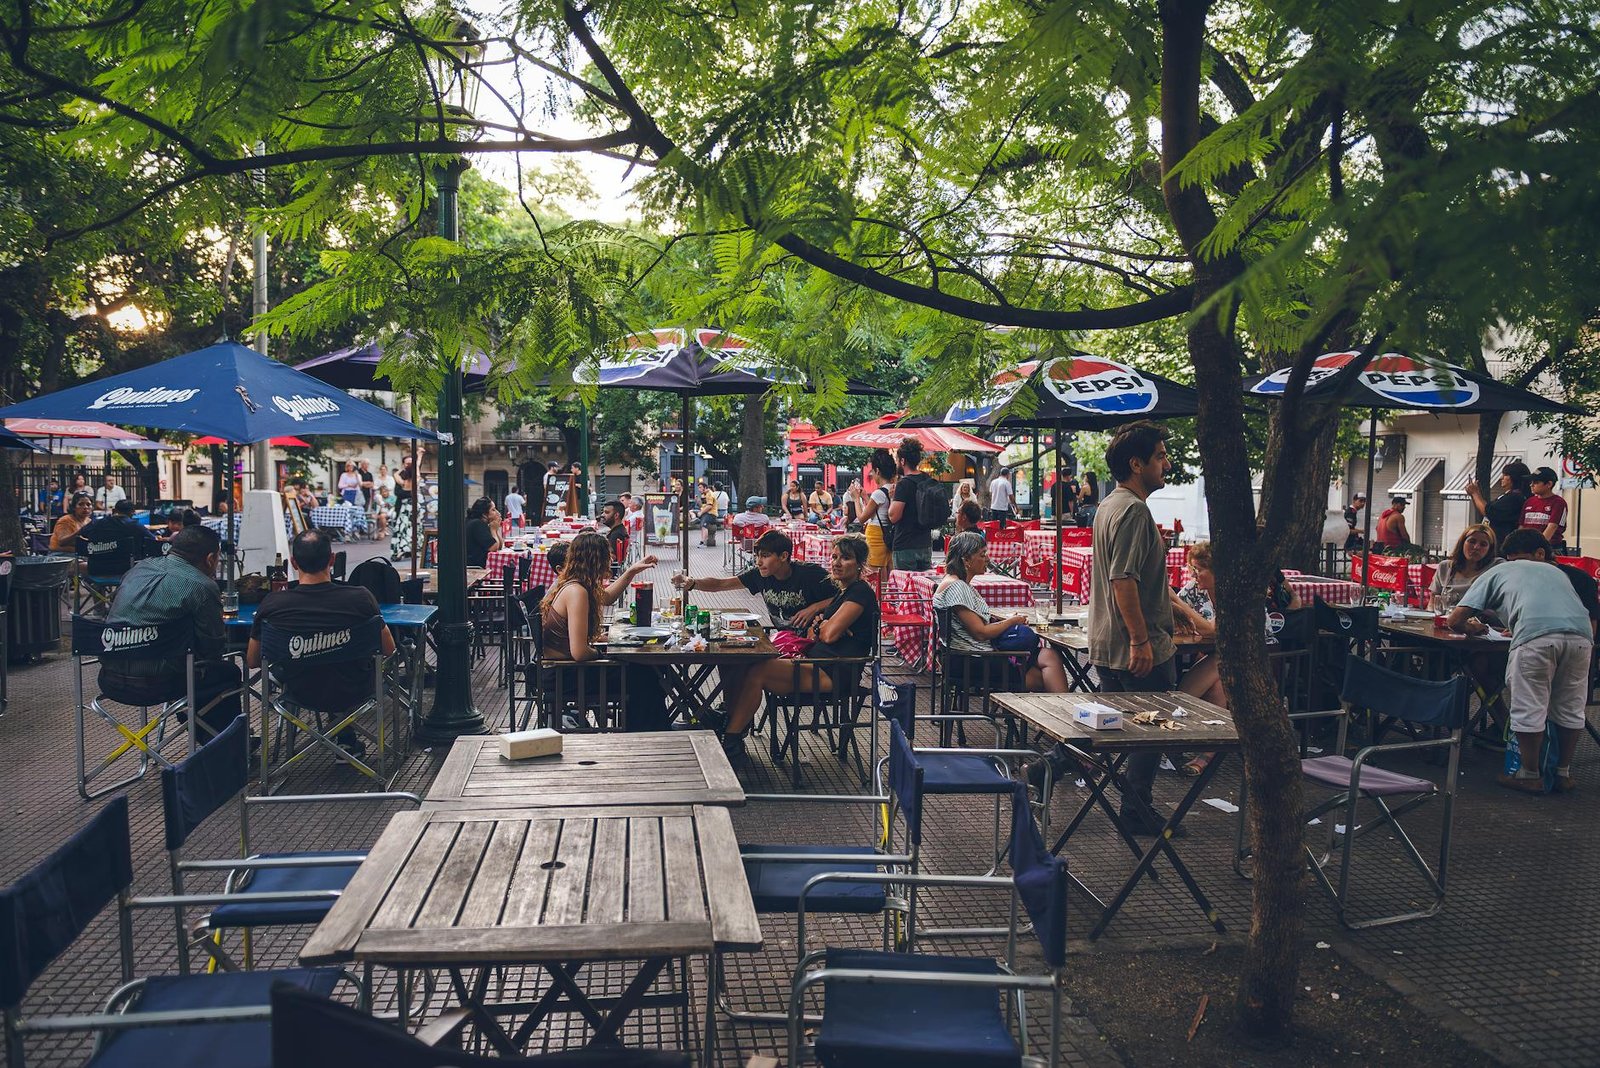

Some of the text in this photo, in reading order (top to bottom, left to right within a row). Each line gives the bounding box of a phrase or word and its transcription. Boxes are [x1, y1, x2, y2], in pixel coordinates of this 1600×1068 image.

[1056, 375, 1145, 395] PEPSI
[1366, 373, 1468, 388] PEPSI
[86, 386, 200, 409] Quilmes
[271, 394, 340, 421] Quilmes
[35, 422, 101, 434] Coca-Cola
[87, 540, 117, 555] Quilmes
[1372, 569, 1398, 584] Coca-Cola
[101, 626, 159, 652] Quilmes
[288, 628, 351, 659] Quilmes
